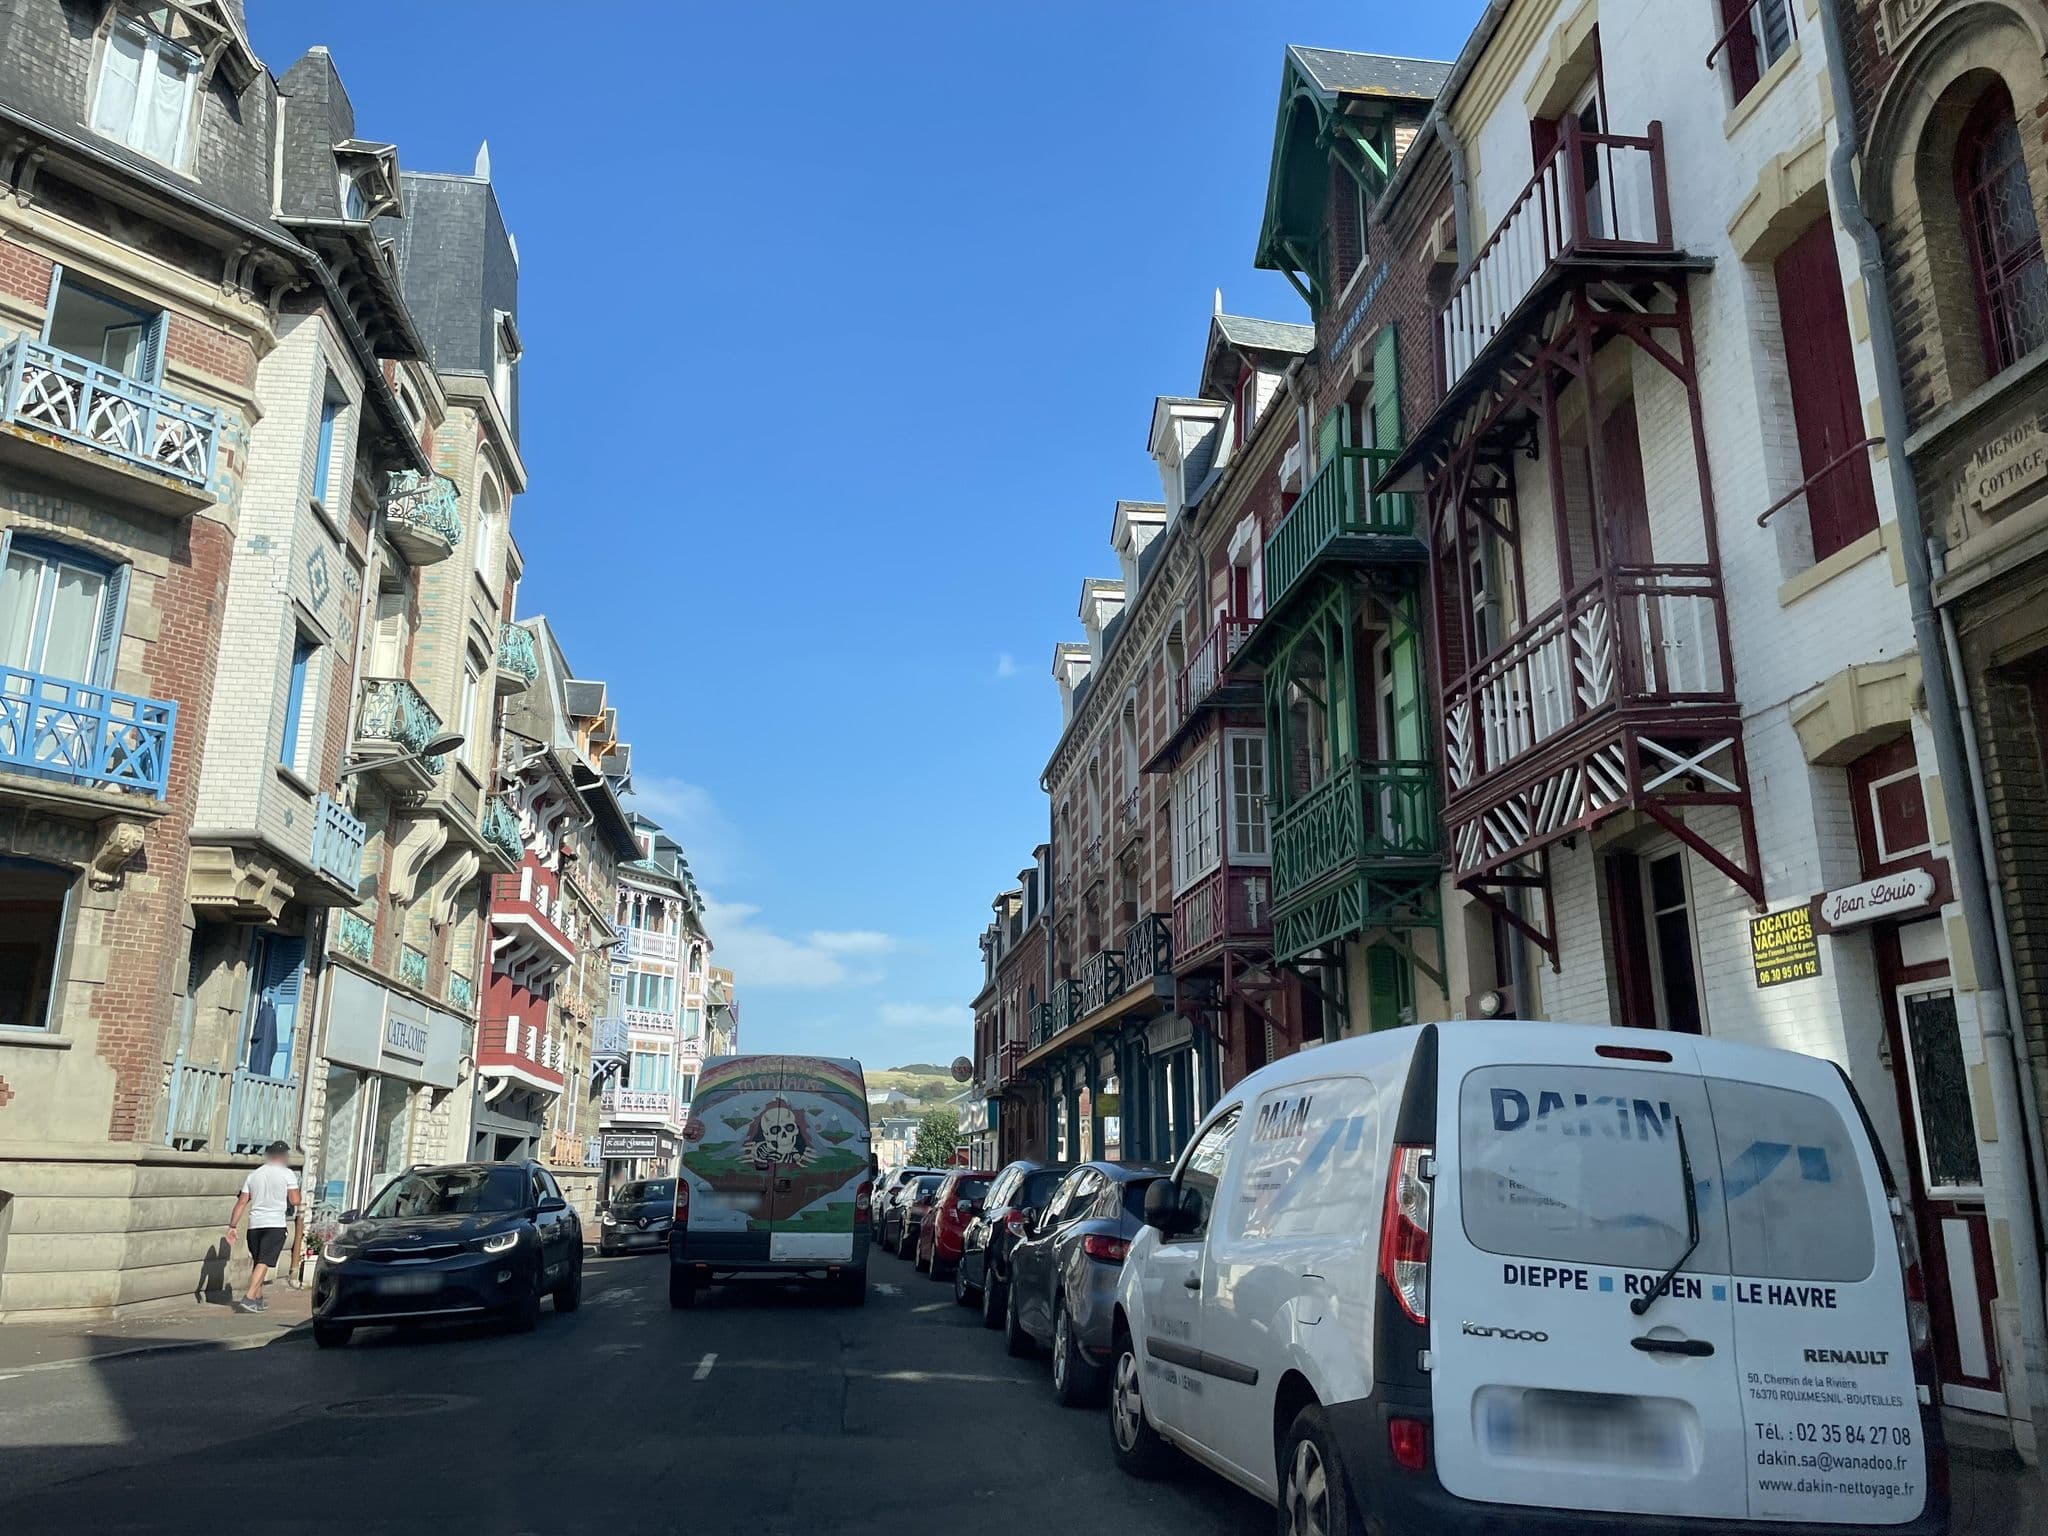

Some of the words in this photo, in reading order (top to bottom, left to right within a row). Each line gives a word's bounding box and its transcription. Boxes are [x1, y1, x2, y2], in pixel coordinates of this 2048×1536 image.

[1979, 448, 2045, 498] COTTAGE
[1833, 895, 1865, 921] Jean
[1868, 877, 1916, 906] Louis
[1753, 907, 1810, 936] LOCATION
[1753, 923, 1813, 951] VACANCES
[1759, 970, 1770, 984] 06
[1781, 966, 1793, 979] 95
[1793, 963, 1804, 977] 01
[1503, 1263, 1589, 1291] DIEPPE
[1623, 1273, 1702, 1300] ROUEN
[1736, 1282, 1763, 1305] LE
[1768, 1285, 1837, 1309] HAVRE
[1803, 1348, 1890, 1366] RENAULT
[1763, 1372, 1800, 1386] Chemin
[1802, 1375, 1813, 1387] de
[1815, 1376, 1825, 1388] la
[1749, 1388, 1778, 1401] 76370
[1780, 1390, 1903, 1407] ROUXMESNIL-BOUTEILLES
[1755, 1422, 1784, 1441] Tél.
[1796, 1422, 1817, 1442] 02
[1822, 1424, 1842, 1443] 35
[1845, 1425, 1866, 1444] 84
[1870, 1426, 1887, 1445] 27
[1892, 1427, 1911, 1446] 08
[1757, 1450, 1908, 1472] dakin.sa@wanadoo.fr
[1758, 1477, 1915, 1499] www.dakin-nettoyage.fr
